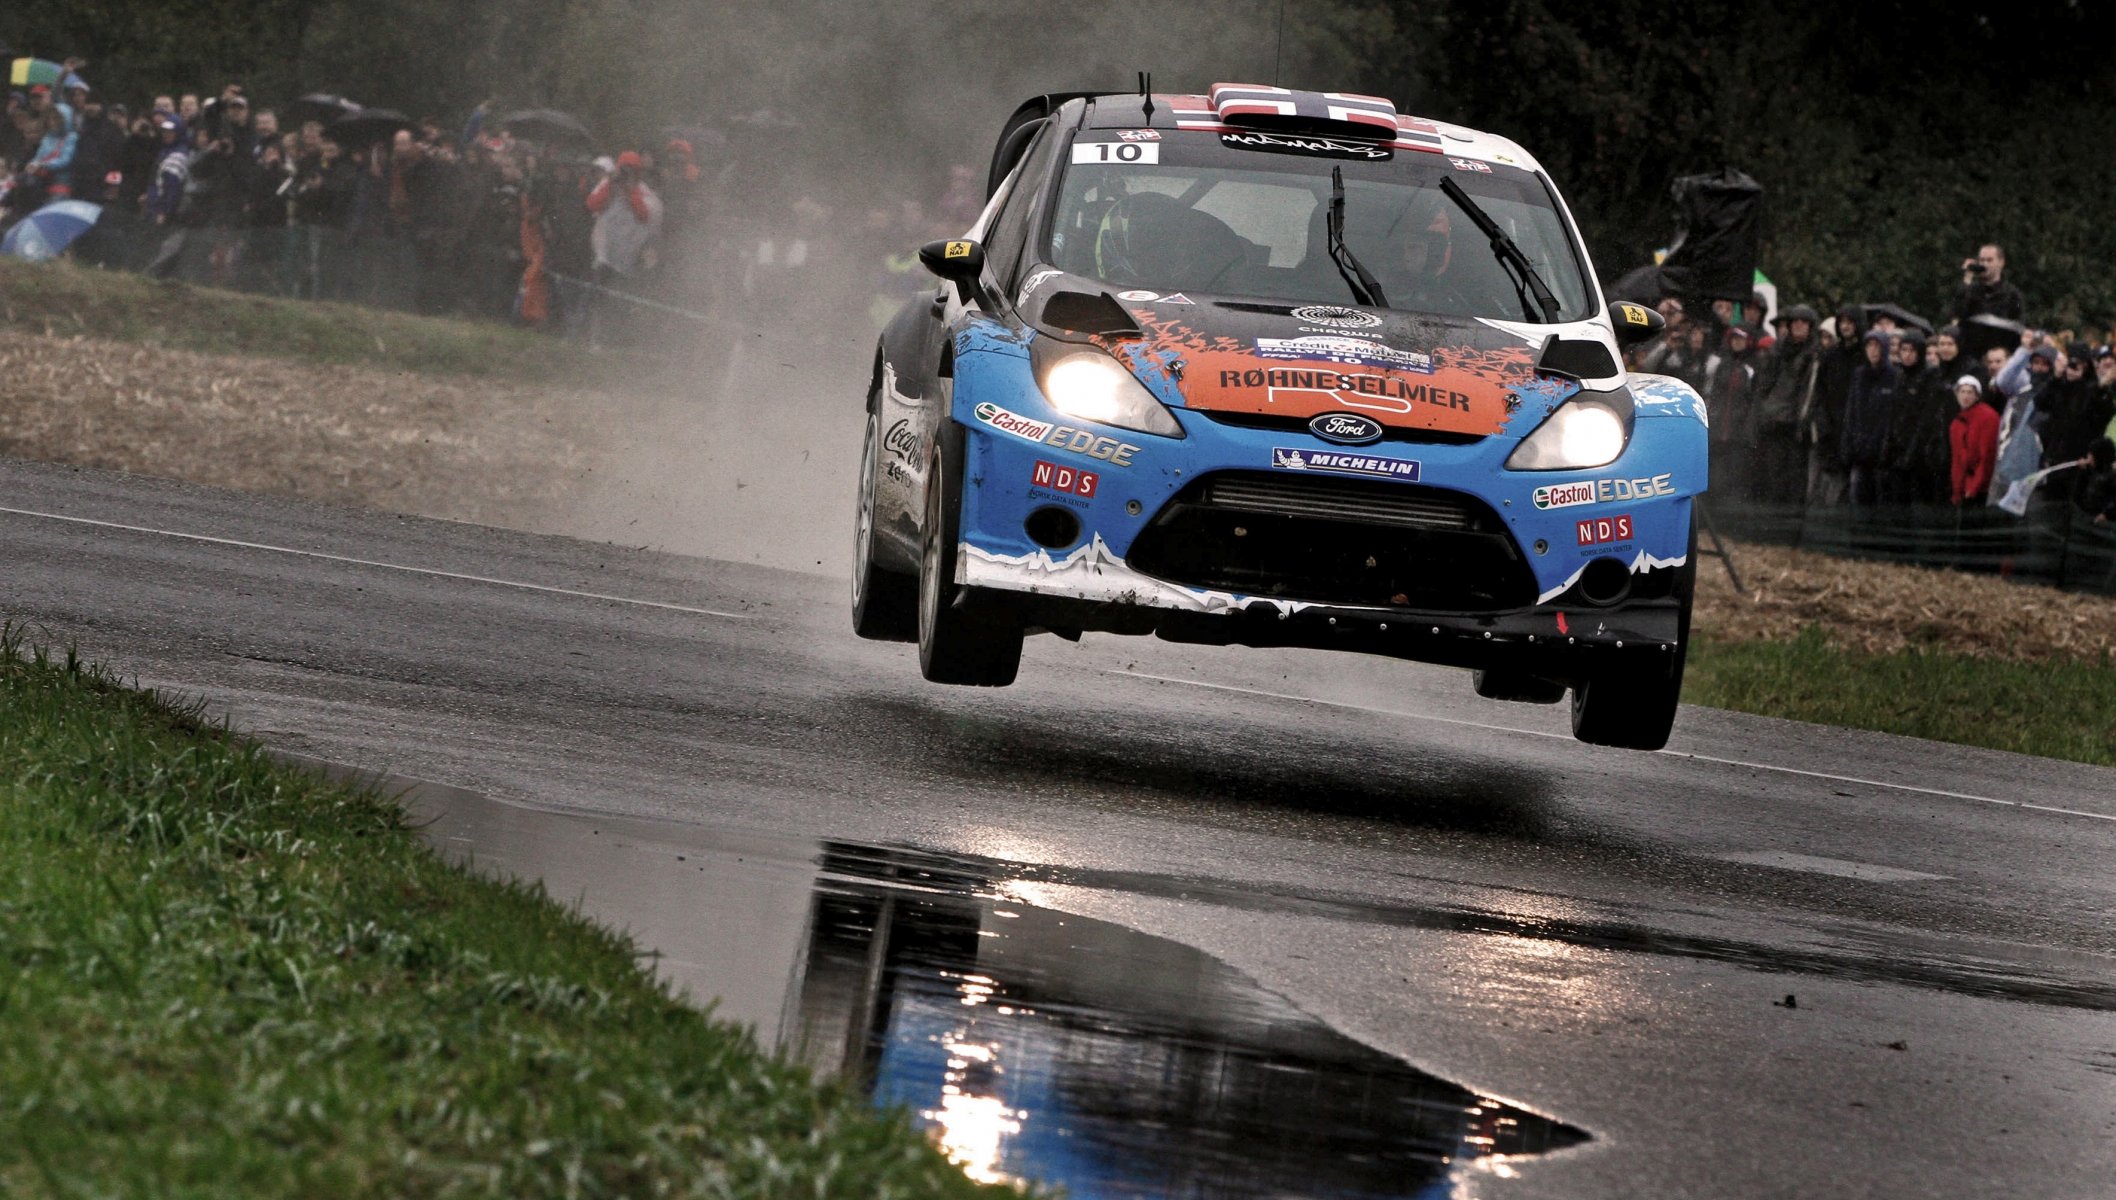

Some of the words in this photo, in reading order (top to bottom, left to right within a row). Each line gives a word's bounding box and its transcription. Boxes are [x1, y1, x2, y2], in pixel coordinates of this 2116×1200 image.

[1095, 144, 1142, 161] 10
[1260, 347, 1327, 355] RALLYE
[1280, 341, 1331, 350] Crédit
[1326, 356, 1362, 365] 10
[1220, 368, 1470, 413] RØHNESELMER
[1325, 417, 1365, 436] Ford
[992, 412, 1049, 440] Castrol
[1046, 426, 1142, 467] EDGE
[1310, 454, 1413, 474] MICHELIN
[1035, 464, 1093, 494] NDS
[1550, 484, 1593, 505] Castrol
[1598, 473, 1676, 502] EDGE
[1579, 518, 1629, 543] NDS
